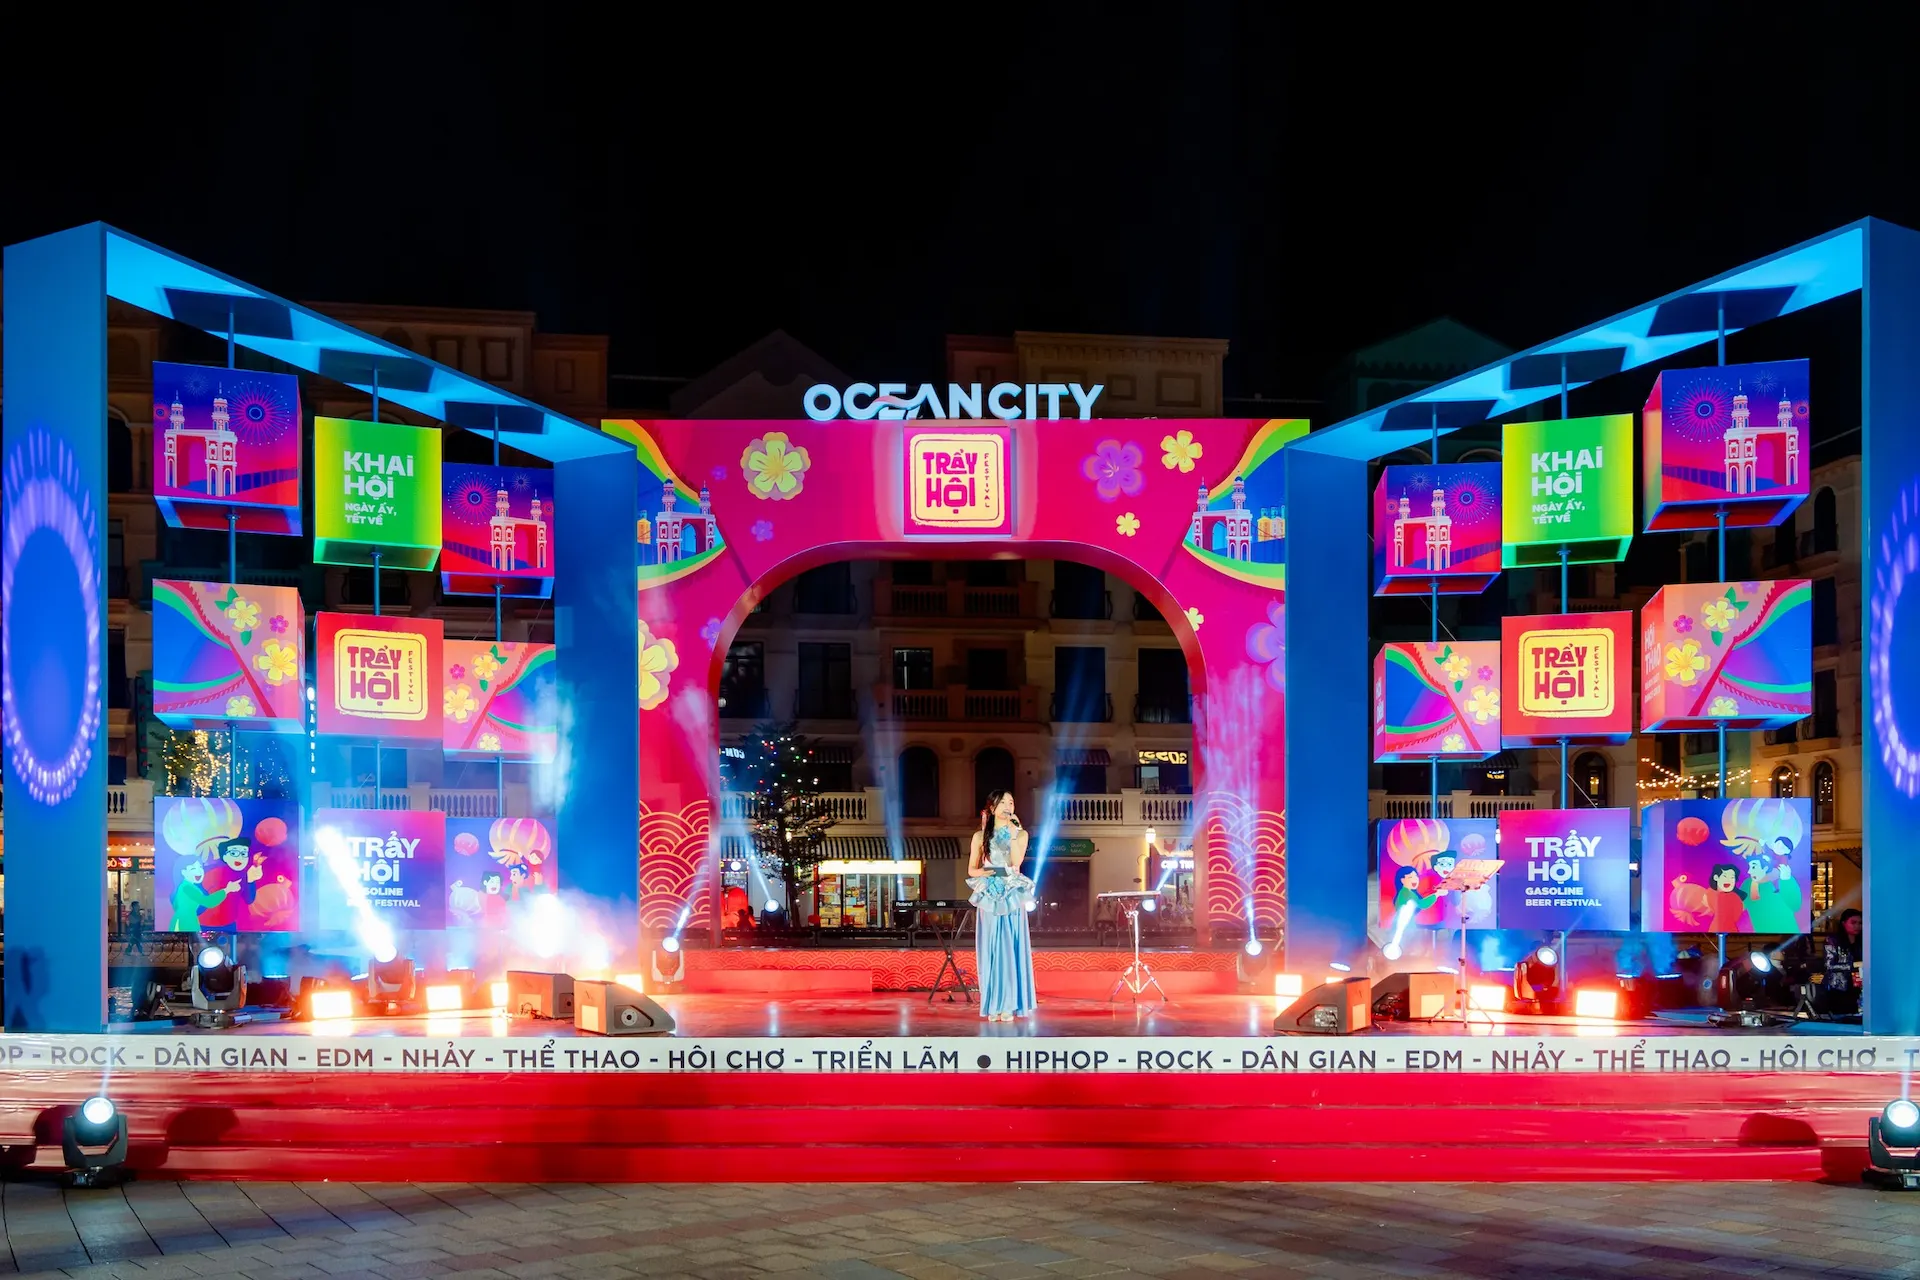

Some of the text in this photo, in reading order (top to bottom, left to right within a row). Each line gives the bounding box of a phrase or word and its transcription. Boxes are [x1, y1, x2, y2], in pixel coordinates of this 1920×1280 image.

[983, 452, 991, 508] FESTIVAL
[926, 477, 976, 514] HỘI
[344, 502, 376, 513] NGÀY
[1532, 501, 1564, 512] NGÀY
[344, 512, 384, 525] TẾT VỀ
[1532, 510, 1571, 525] TẾT VỀ
[350, 670, 400, 706] HỘI
[1534, 669, 1585, 705] HỘI
[1525, 886, 1584, 896] GASOLINE
[375, 899, 421, 907] FESTIVAL
[1525, 898, 1603, 907] BEER FESTIVAL
[51, 1046, 126, 1066] ROCK
[154, 1042, 210, 1066] DÂN
[220, 1047, 288, 1067] GIAN
[316, 1048, 373, 1067] EDM
[402, 1041, 475, 1068] NHẢY
[503, 1039, 555, 1068] THỂ
[564, 1049, 640, 1068] THAO
[812, 1040, 892, 1069] TRIỂN
[903, 1045, 959, 1069] LÃM
[1006, 1051, 1109, 1069] HIPHOP
[1137, 1050, 1213, 1069] ROCK
[1242, 1045, 1298, 1069] DÂN
[1309, 1050, 1376, 1069] GIAN
[1405, 1050, 1462, 1069] EDM
[1492, 1042, 1565, 1069] NHẢY
[1596, 1039, 1645, 1068] THỂ
[1655, 1050, 1731, 1068] THAO
